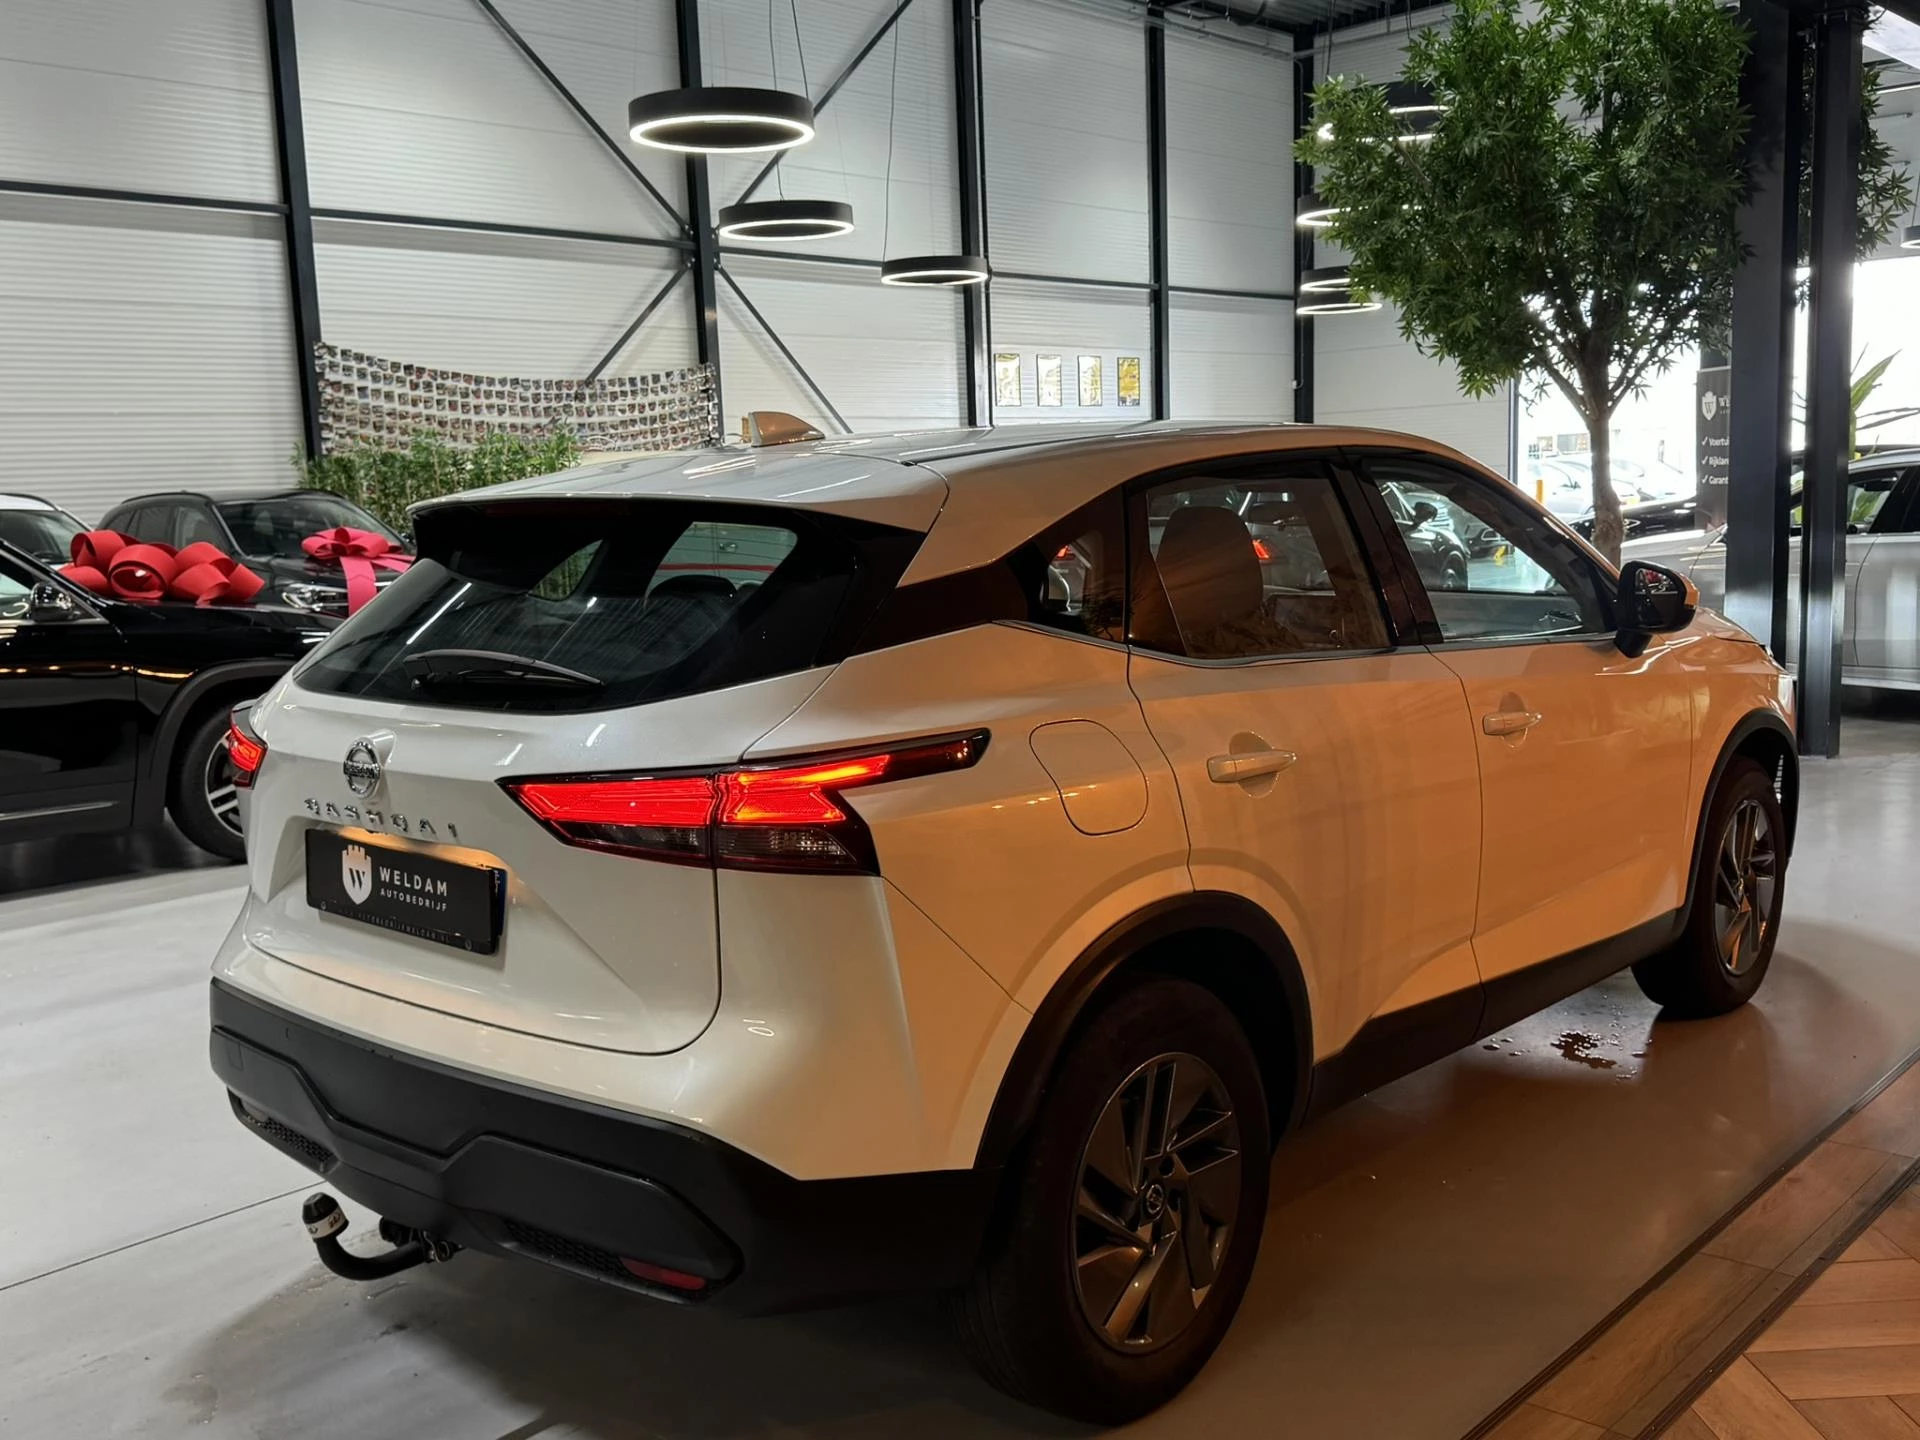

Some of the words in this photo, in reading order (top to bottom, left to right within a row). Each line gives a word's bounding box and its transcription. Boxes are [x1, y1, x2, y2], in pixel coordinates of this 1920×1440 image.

[304, 798, 458, 838] QASHQAI
[379, 866, 448, 897] WELDAM
[379, 888, 448, 912] AUTOBEDRIJF
